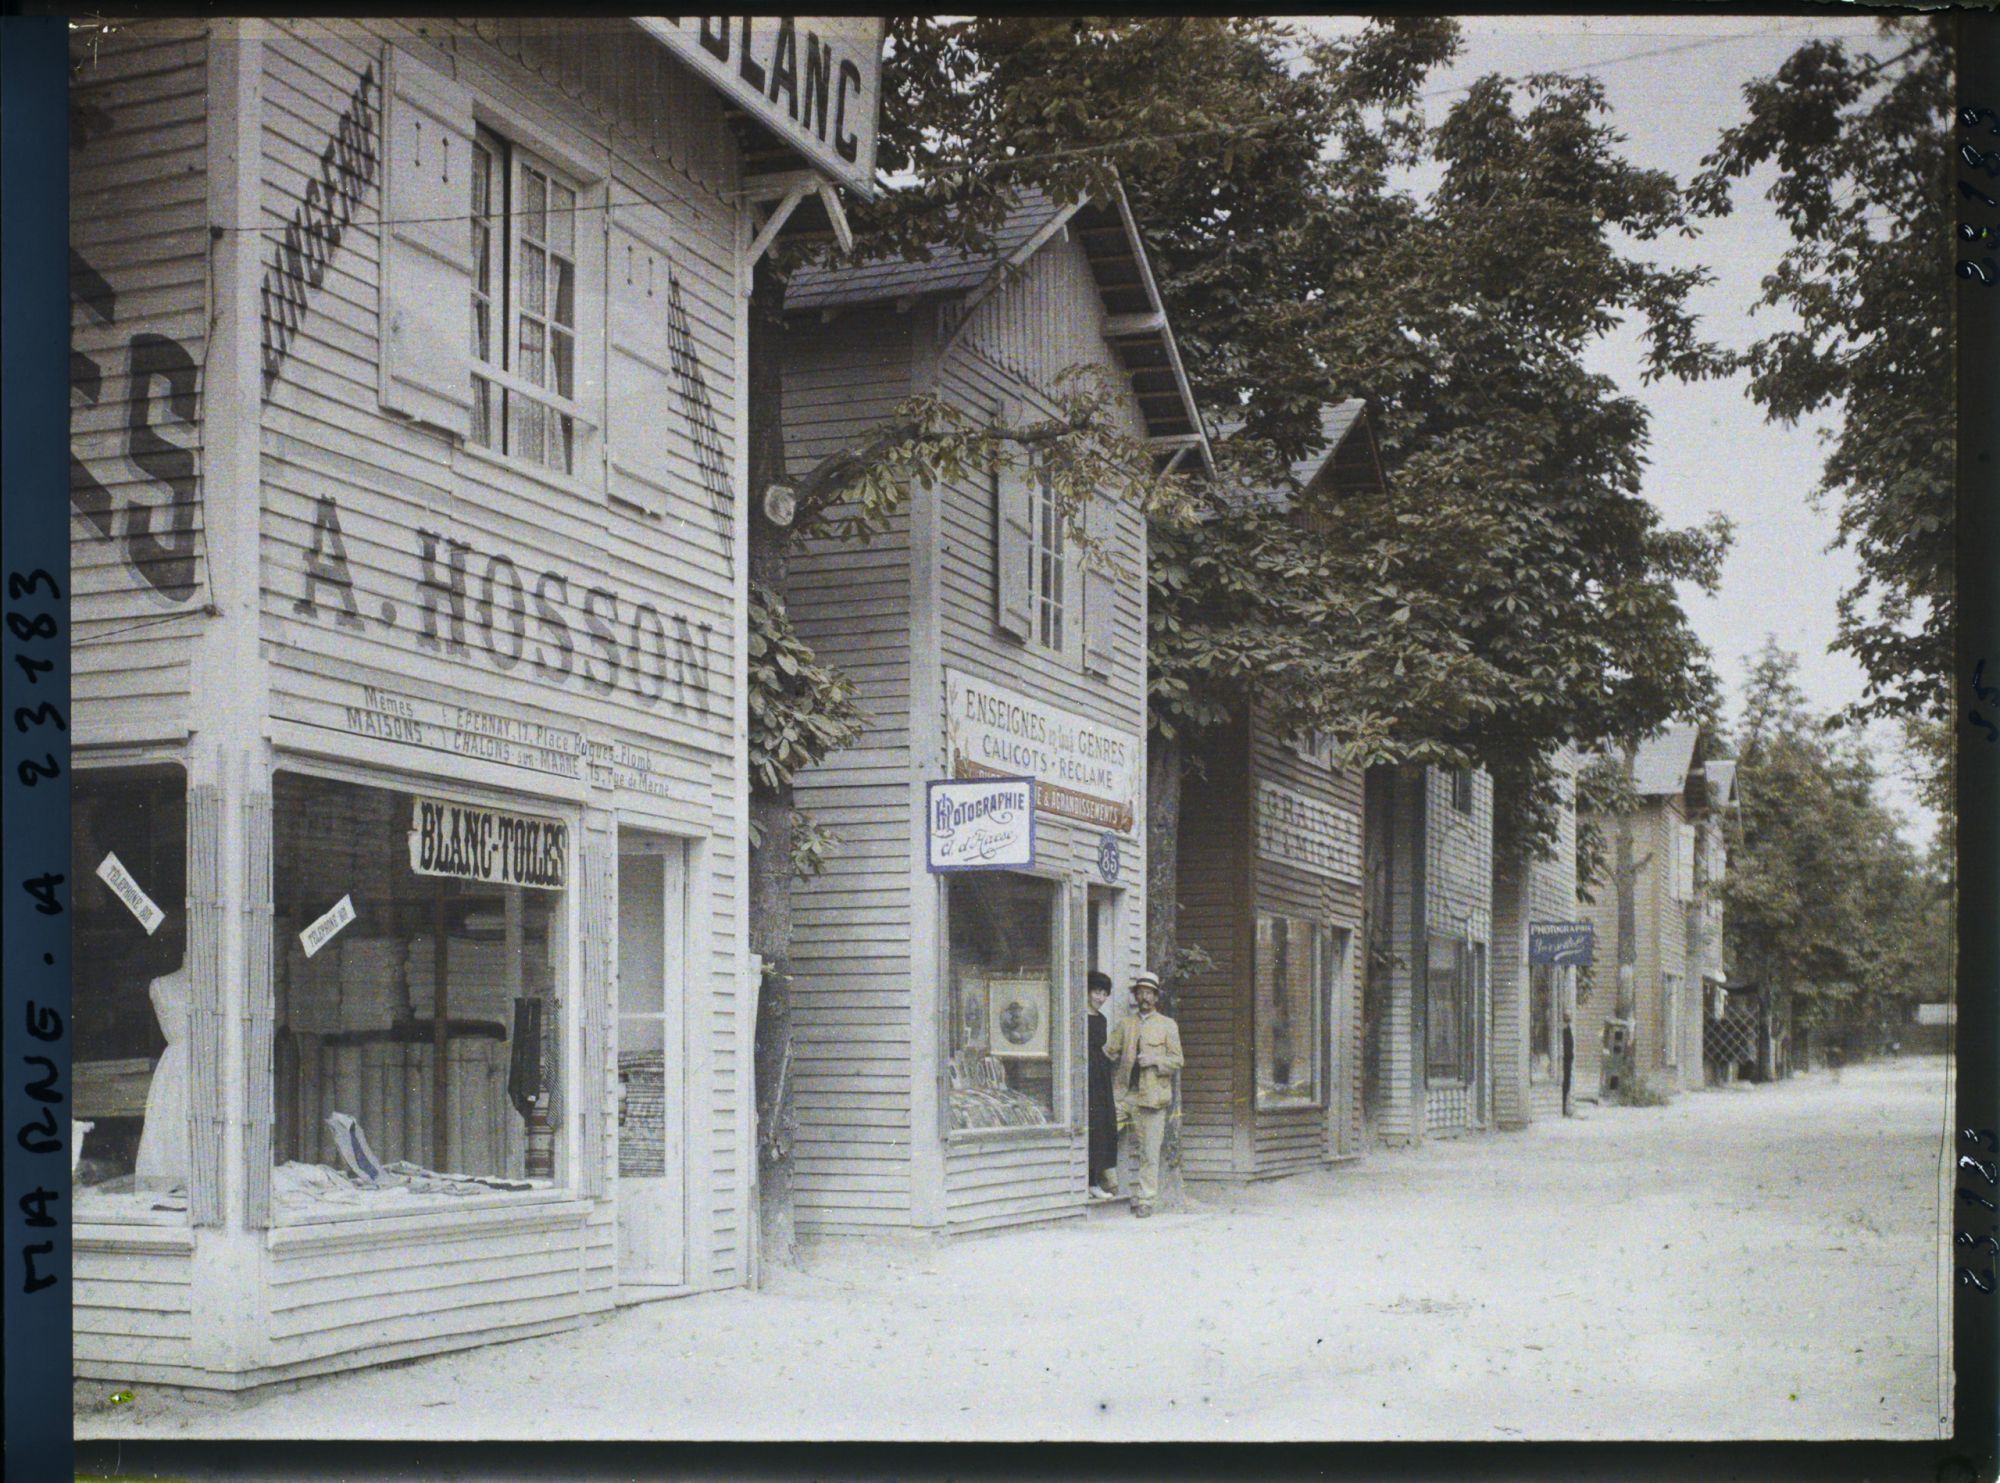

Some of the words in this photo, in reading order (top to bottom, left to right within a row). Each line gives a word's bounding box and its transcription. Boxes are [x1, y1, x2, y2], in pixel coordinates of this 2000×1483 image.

[414, 526, 713, 722] HOSSON
[6, 568, 67, 787] 23183
[536, 724, 568, 751] Place
[966, 688, 1046, 743] ENSEIGNES
[1078, 730, 1125, 768] GENRES
[982, 734, 1047, 772] CALICOTS
[1051, 790, 1118, 824] AGRANDISSEMENTS
